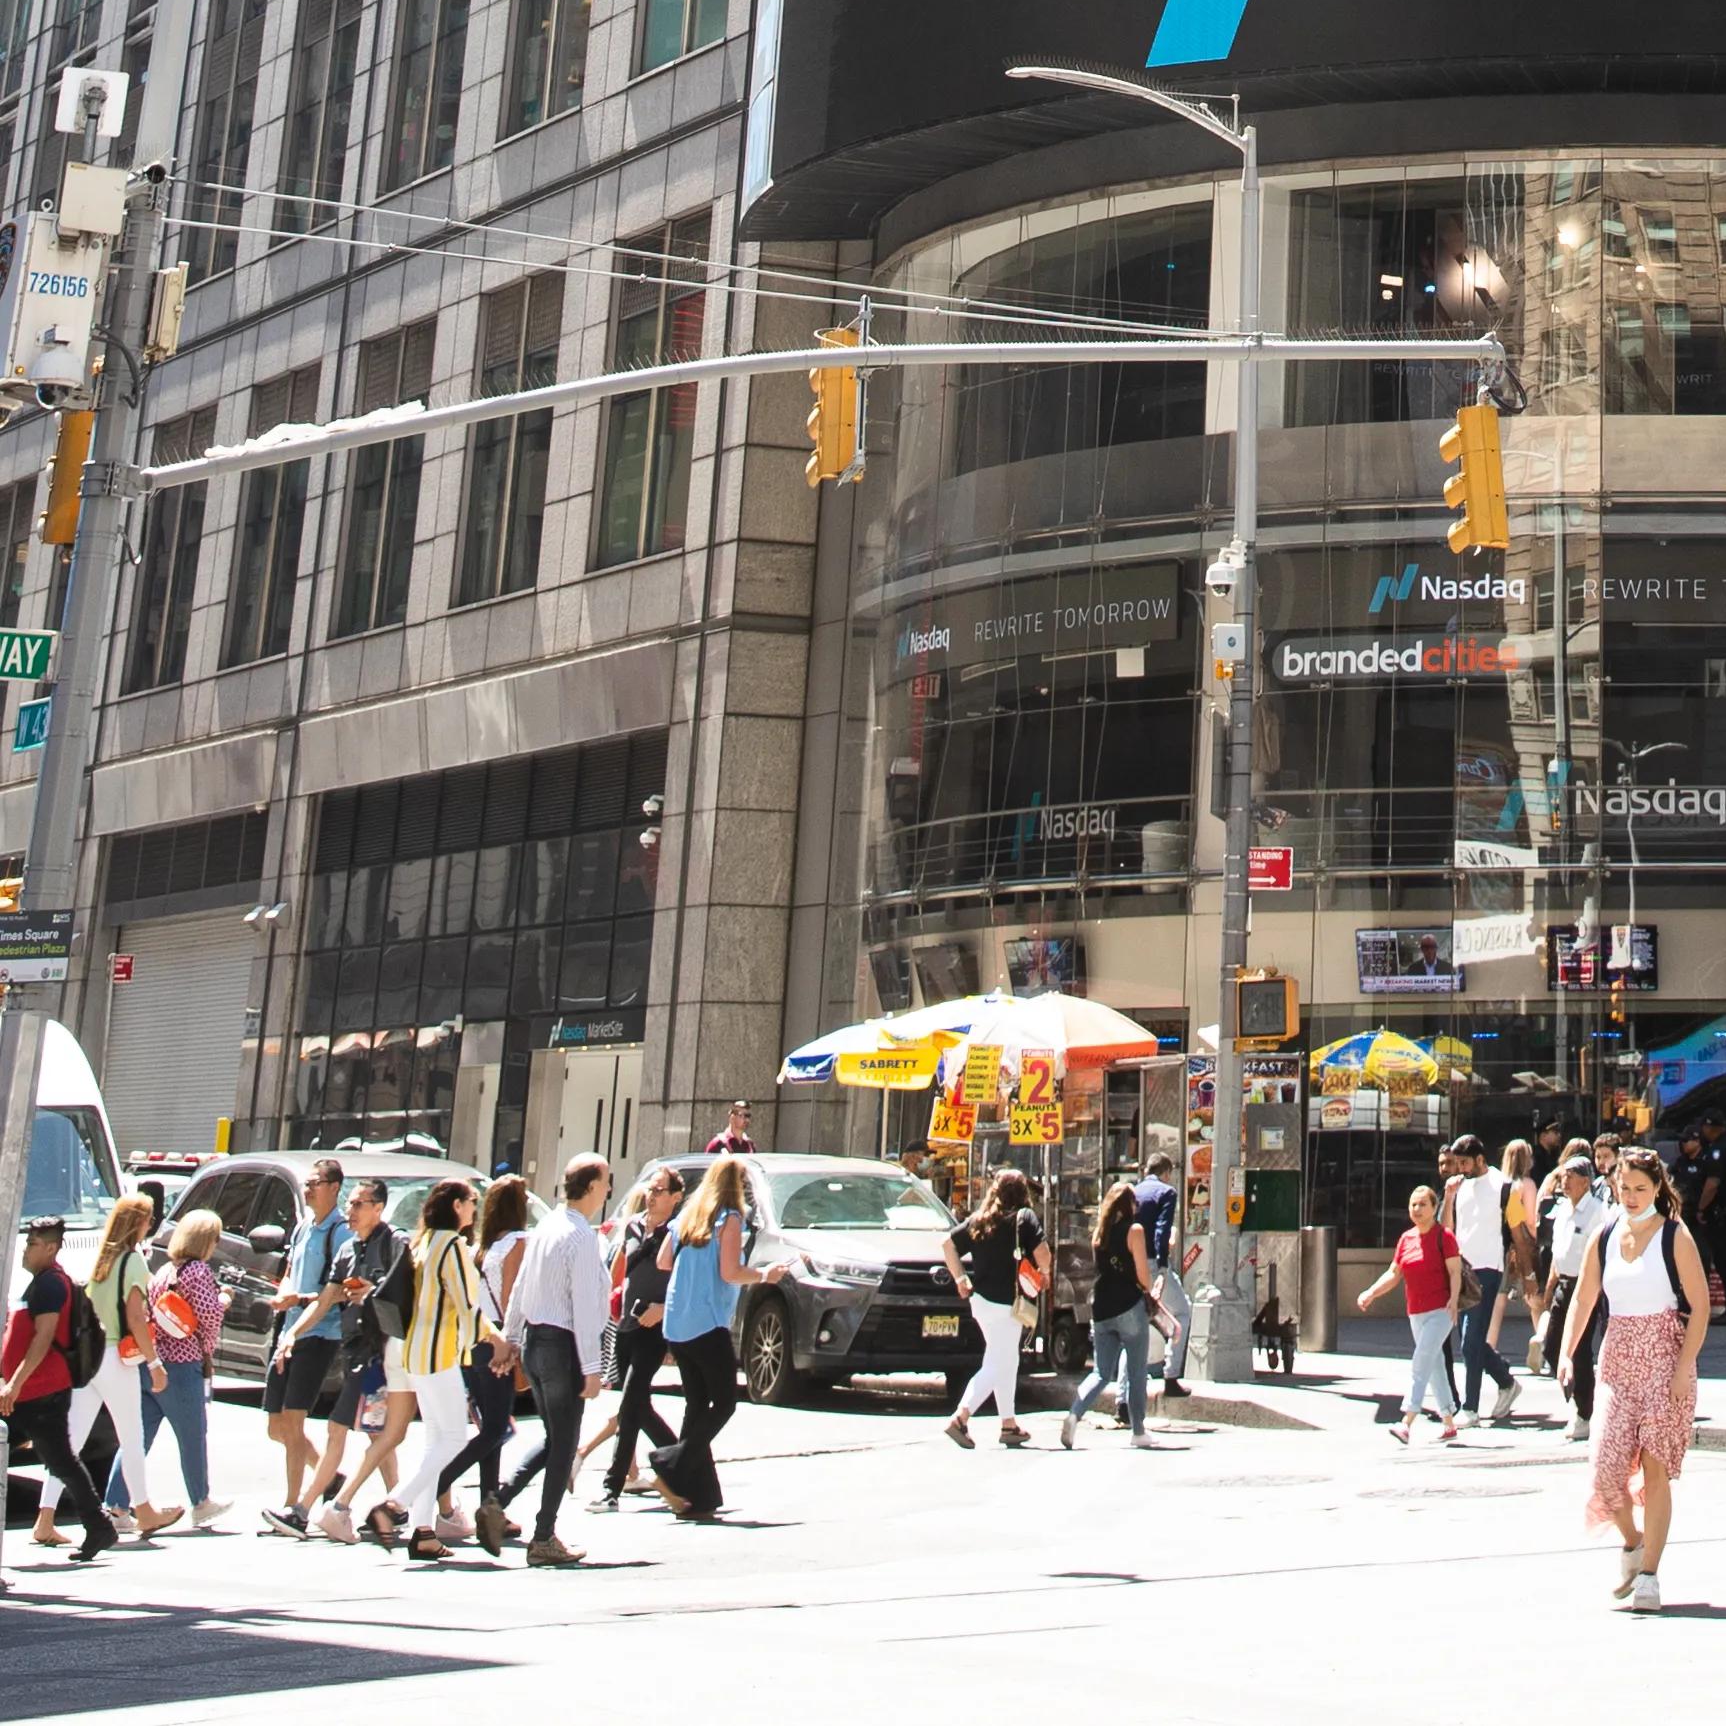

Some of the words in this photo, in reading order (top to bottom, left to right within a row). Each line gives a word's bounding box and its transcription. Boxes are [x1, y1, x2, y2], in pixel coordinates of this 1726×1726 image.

[29, 271, 88, 298] 726156
[1421, 573, 1525, 605] Nasdaq
[1583, 578, 1706, 599] REWRITE
[975, 612, 1044, 643] REWRITE
[1053, 599, 1171, 629] TOMORROW
[910, 627, 950, 653] Nasdaq
[1283, 637, 1518, 676] brandedcities
[18, 710, 29, 745] W
[1575, 778, 1726, 825] Nasdaq
[1040, 805, 1115, 841] Nasdaq
[25, 929, 59, 942] Square
[860, 1059, 918, 1070] SABRETT
